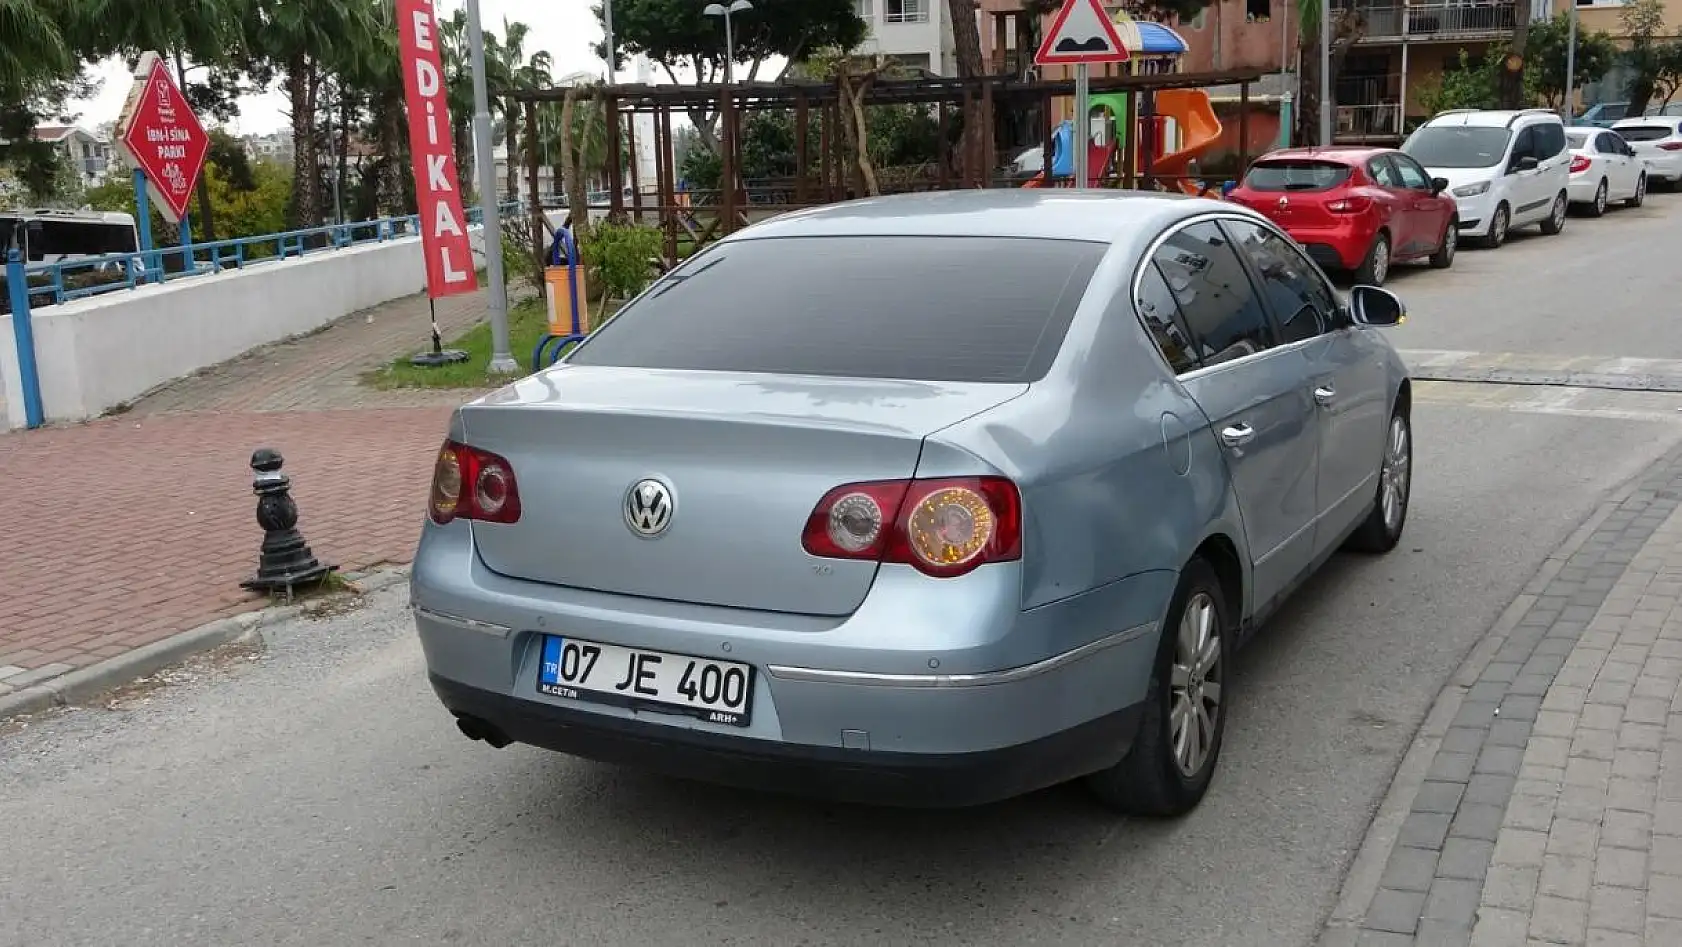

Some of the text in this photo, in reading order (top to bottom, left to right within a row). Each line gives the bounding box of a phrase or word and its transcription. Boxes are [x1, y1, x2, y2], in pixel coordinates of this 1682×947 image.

[170, 126, 191, 142] SİNA
[157, 144, 186, 159] PARKI
[545, 643, 745, 708] TR 07 JE 400
